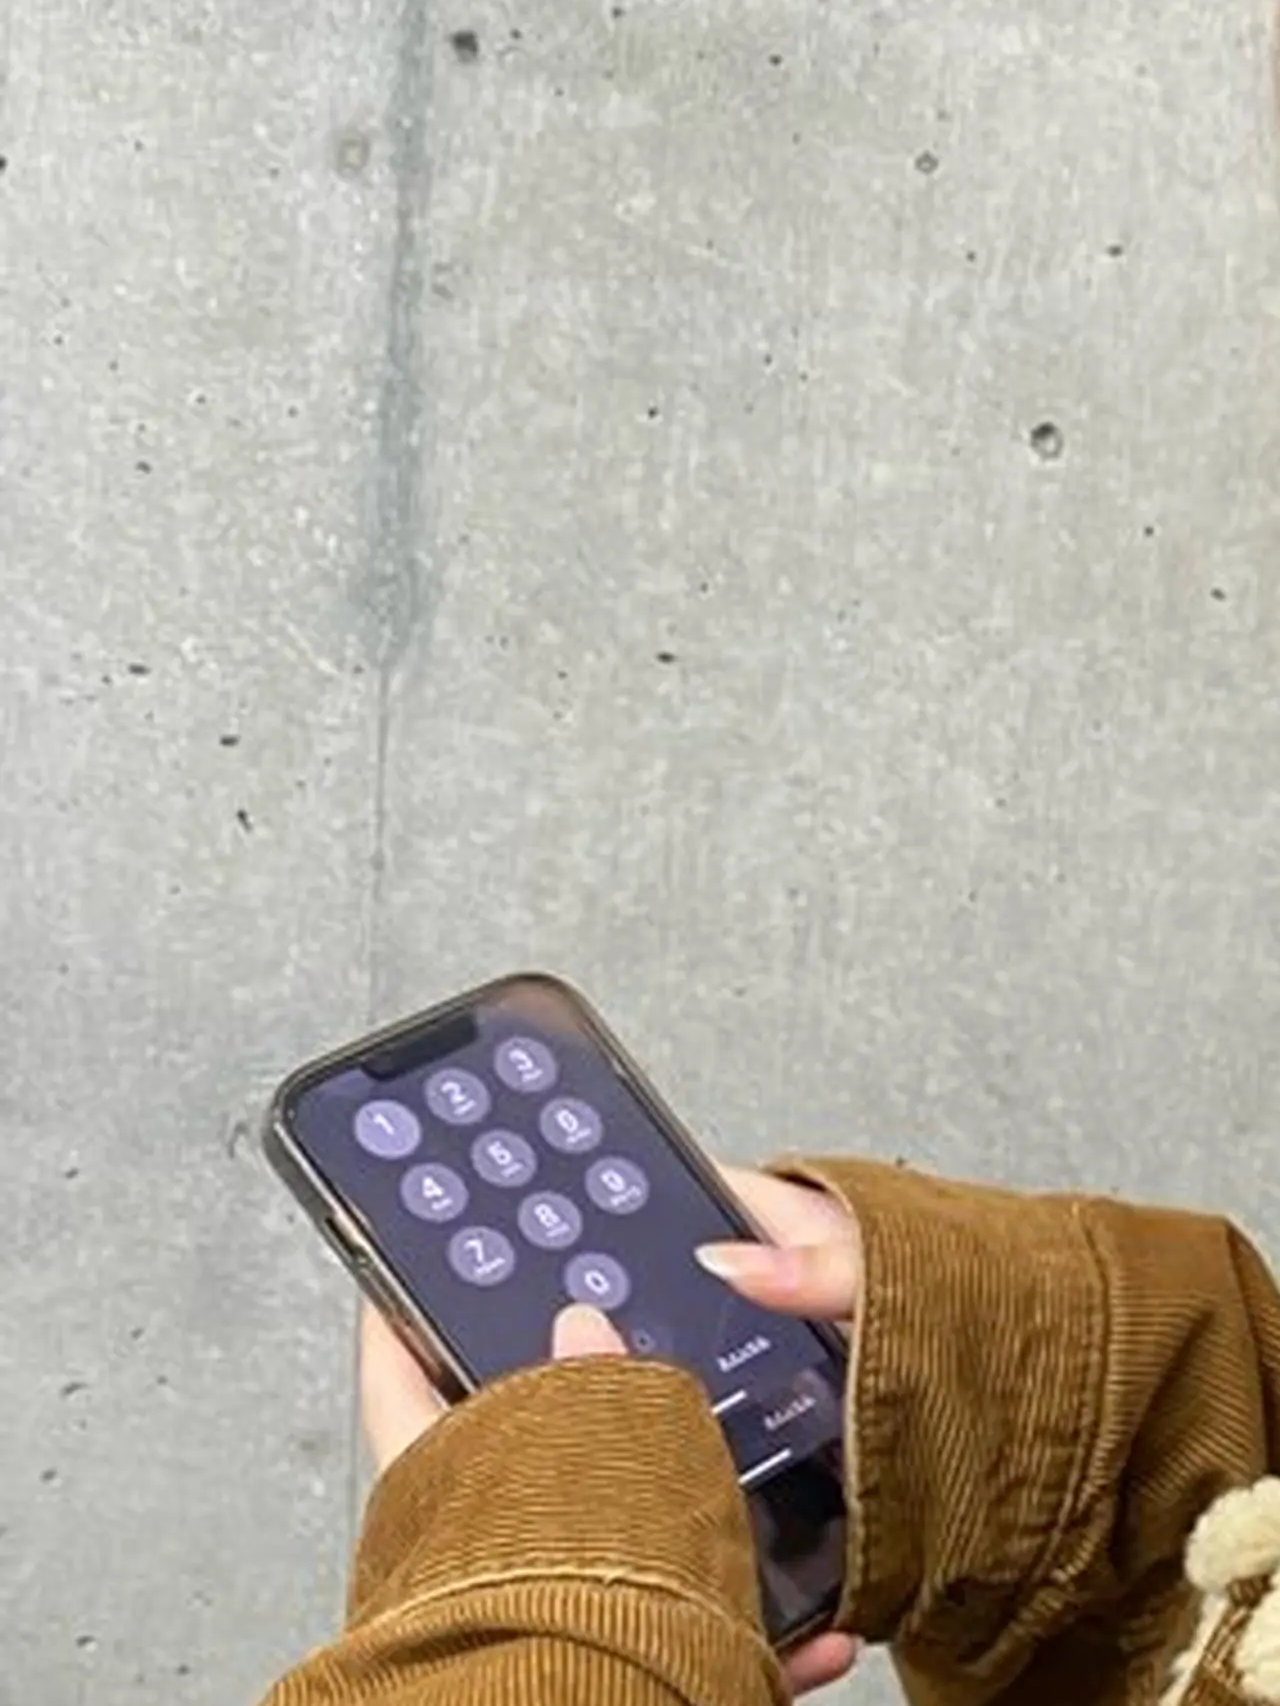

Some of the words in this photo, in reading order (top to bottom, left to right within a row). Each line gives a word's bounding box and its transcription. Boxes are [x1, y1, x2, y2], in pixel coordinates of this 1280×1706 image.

[440, 1081, 467, 1103] 2
[373, 1113, 395, 1135] 1
[487, 1140, 513, 1166] 5
[421, 1176, 446, 1199] 4
[533, 1202, 561, 1228] 8
[462, 1238, 484, 1263] 7
[584, 1269, 611, 1295] 0
